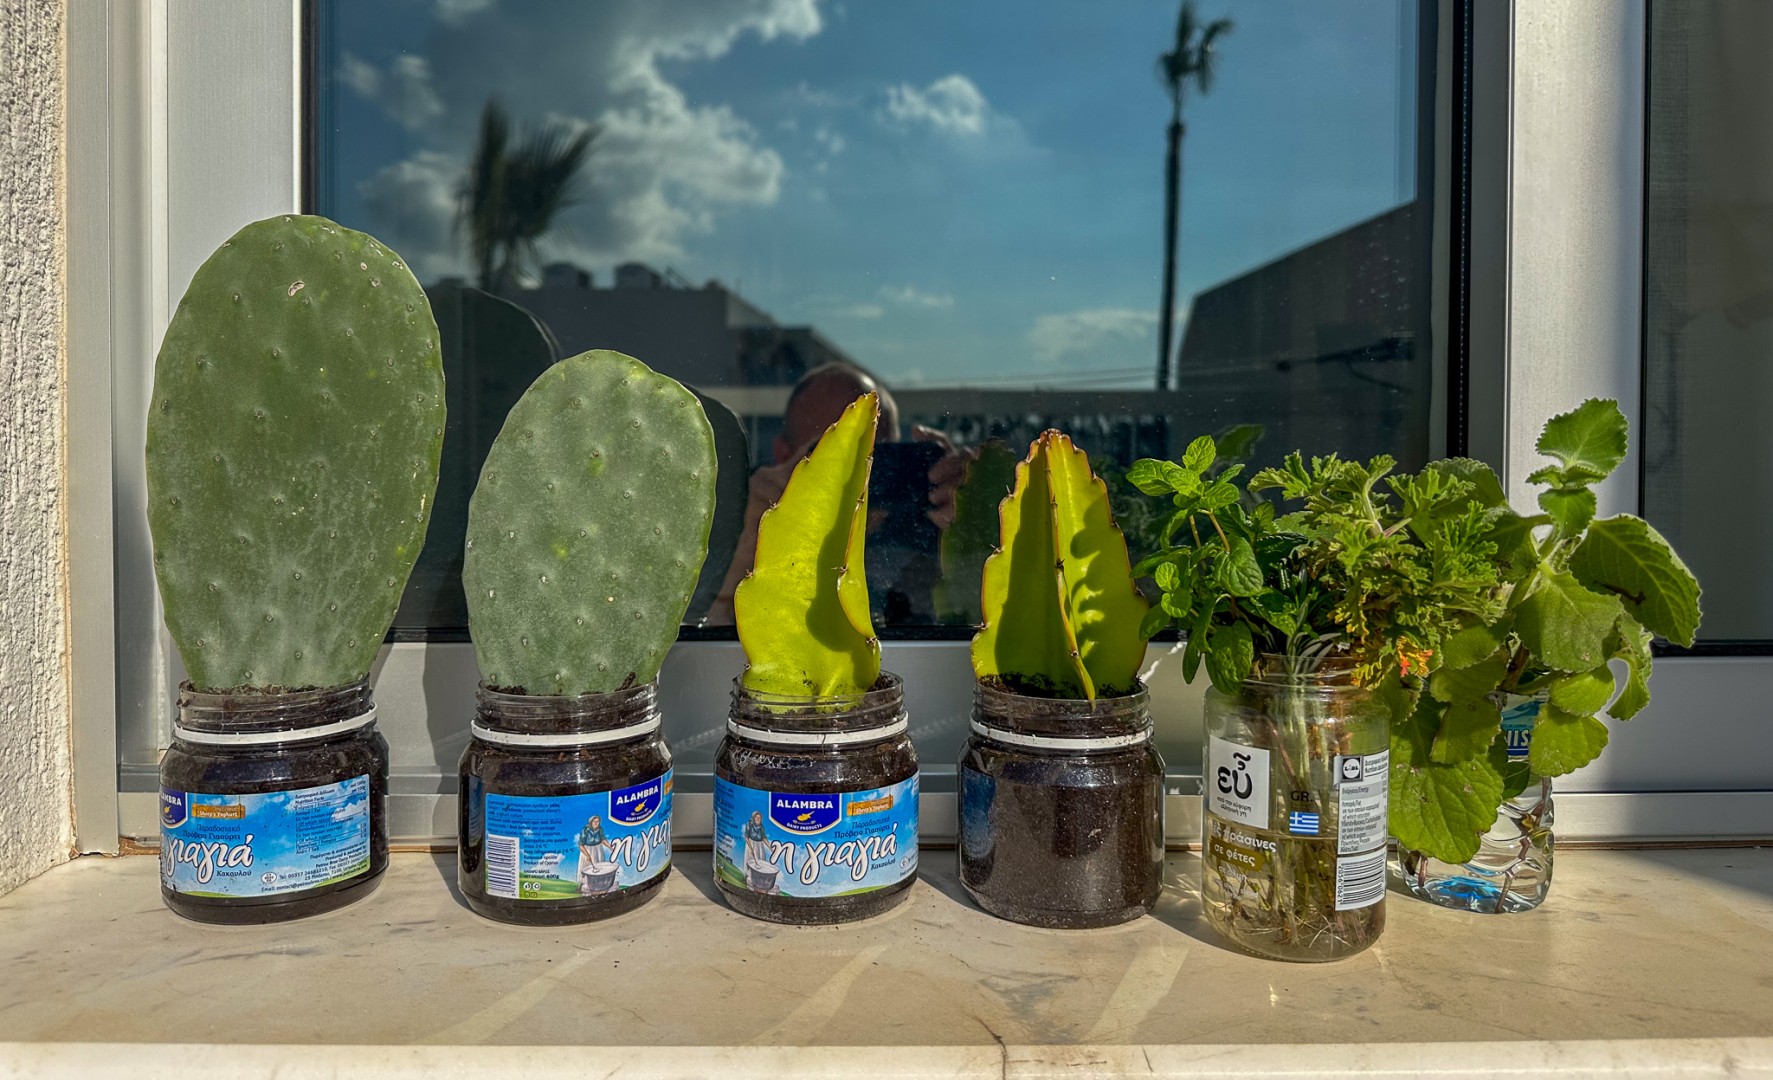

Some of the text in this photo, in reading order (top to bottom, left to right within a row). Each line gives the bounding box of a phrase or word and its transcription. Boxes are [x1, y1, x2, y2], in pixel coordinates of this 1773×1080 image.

[616, 785, 659, 806] ALAMBRA
[776, 800, 834, 809] ALAMBRA
[770, 840, 796, 874] η
[800, 822, 898, 886] γιαγιά
[1214, 844, 1255, 867] σε φέτες
